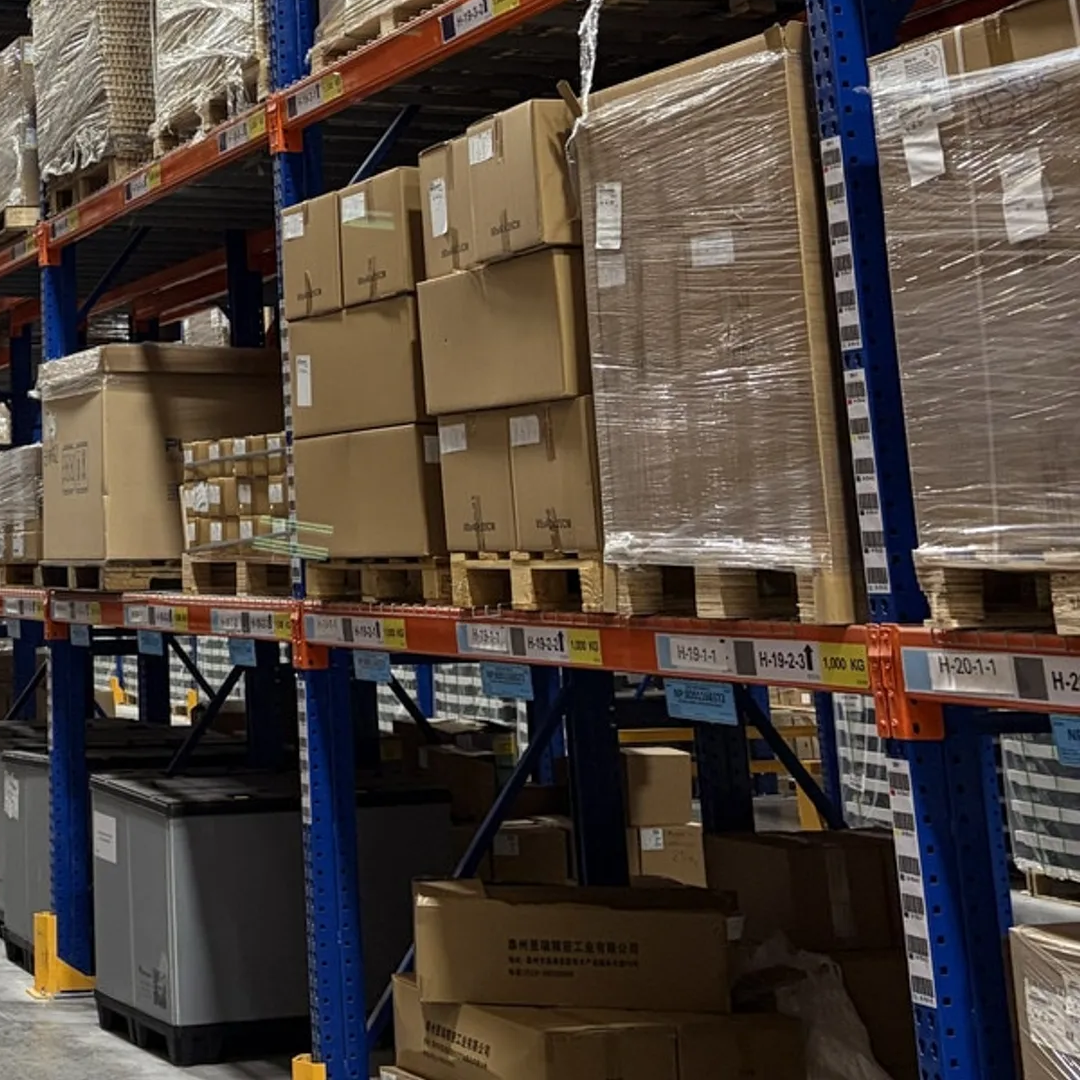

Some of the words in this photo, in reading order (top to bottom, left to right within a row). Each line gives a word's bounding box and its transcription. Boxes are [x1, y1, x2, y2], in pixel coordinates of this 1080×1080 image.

[677, 644, 718, 663] H-19-1-1
[759, 651, 806, 669] H-19-2-3
[823, 656, 847, 671] 1,000
[850, 657, 866, 672] KG
[937, 655, 998, 676] H-20-1-1
